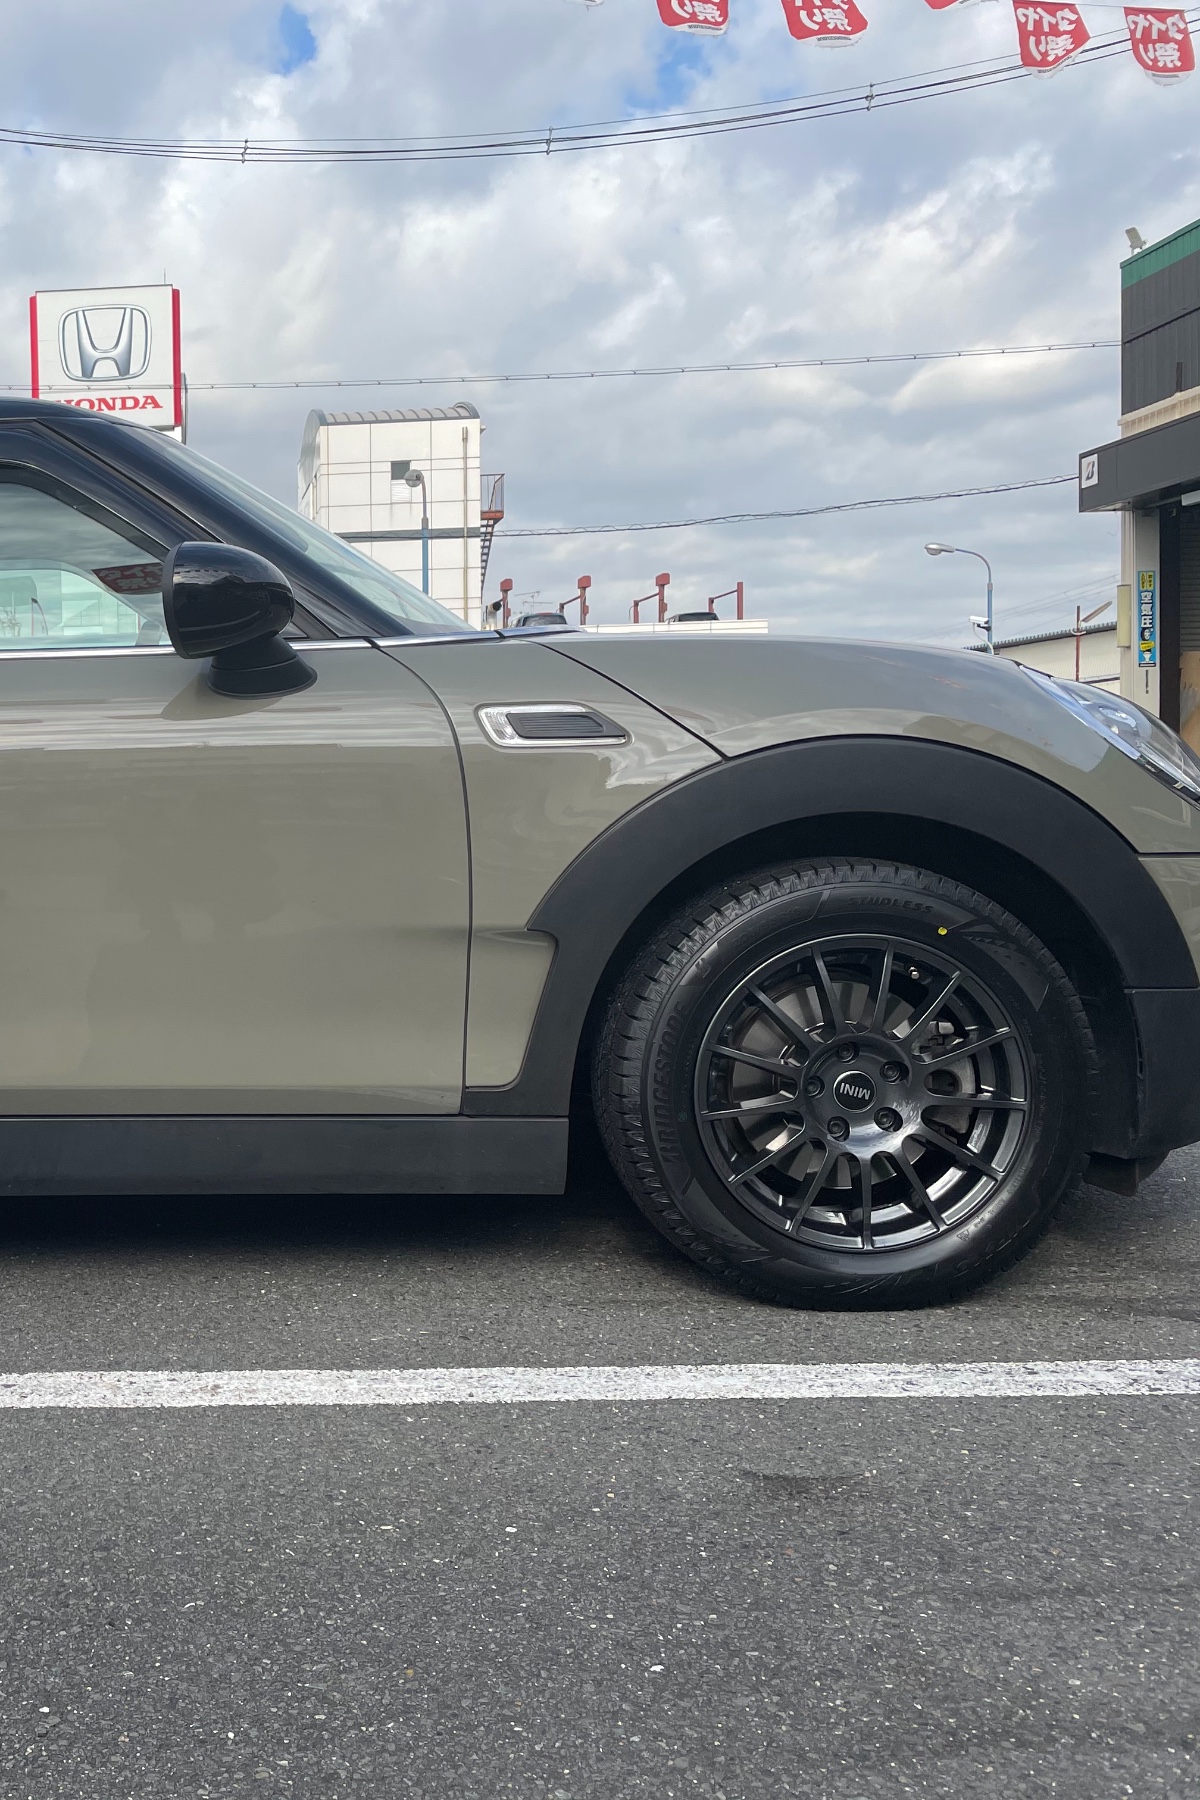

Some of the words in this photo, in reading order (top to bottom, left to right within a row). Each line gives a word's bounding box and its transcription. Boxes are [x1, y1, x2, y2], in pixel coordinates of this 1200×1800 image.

[847, 897, 934, 913] STUDLESS
[654, 1000, 689, 1163] BRIDGESTONE
[839, 1082, 871, 1101] MINI
